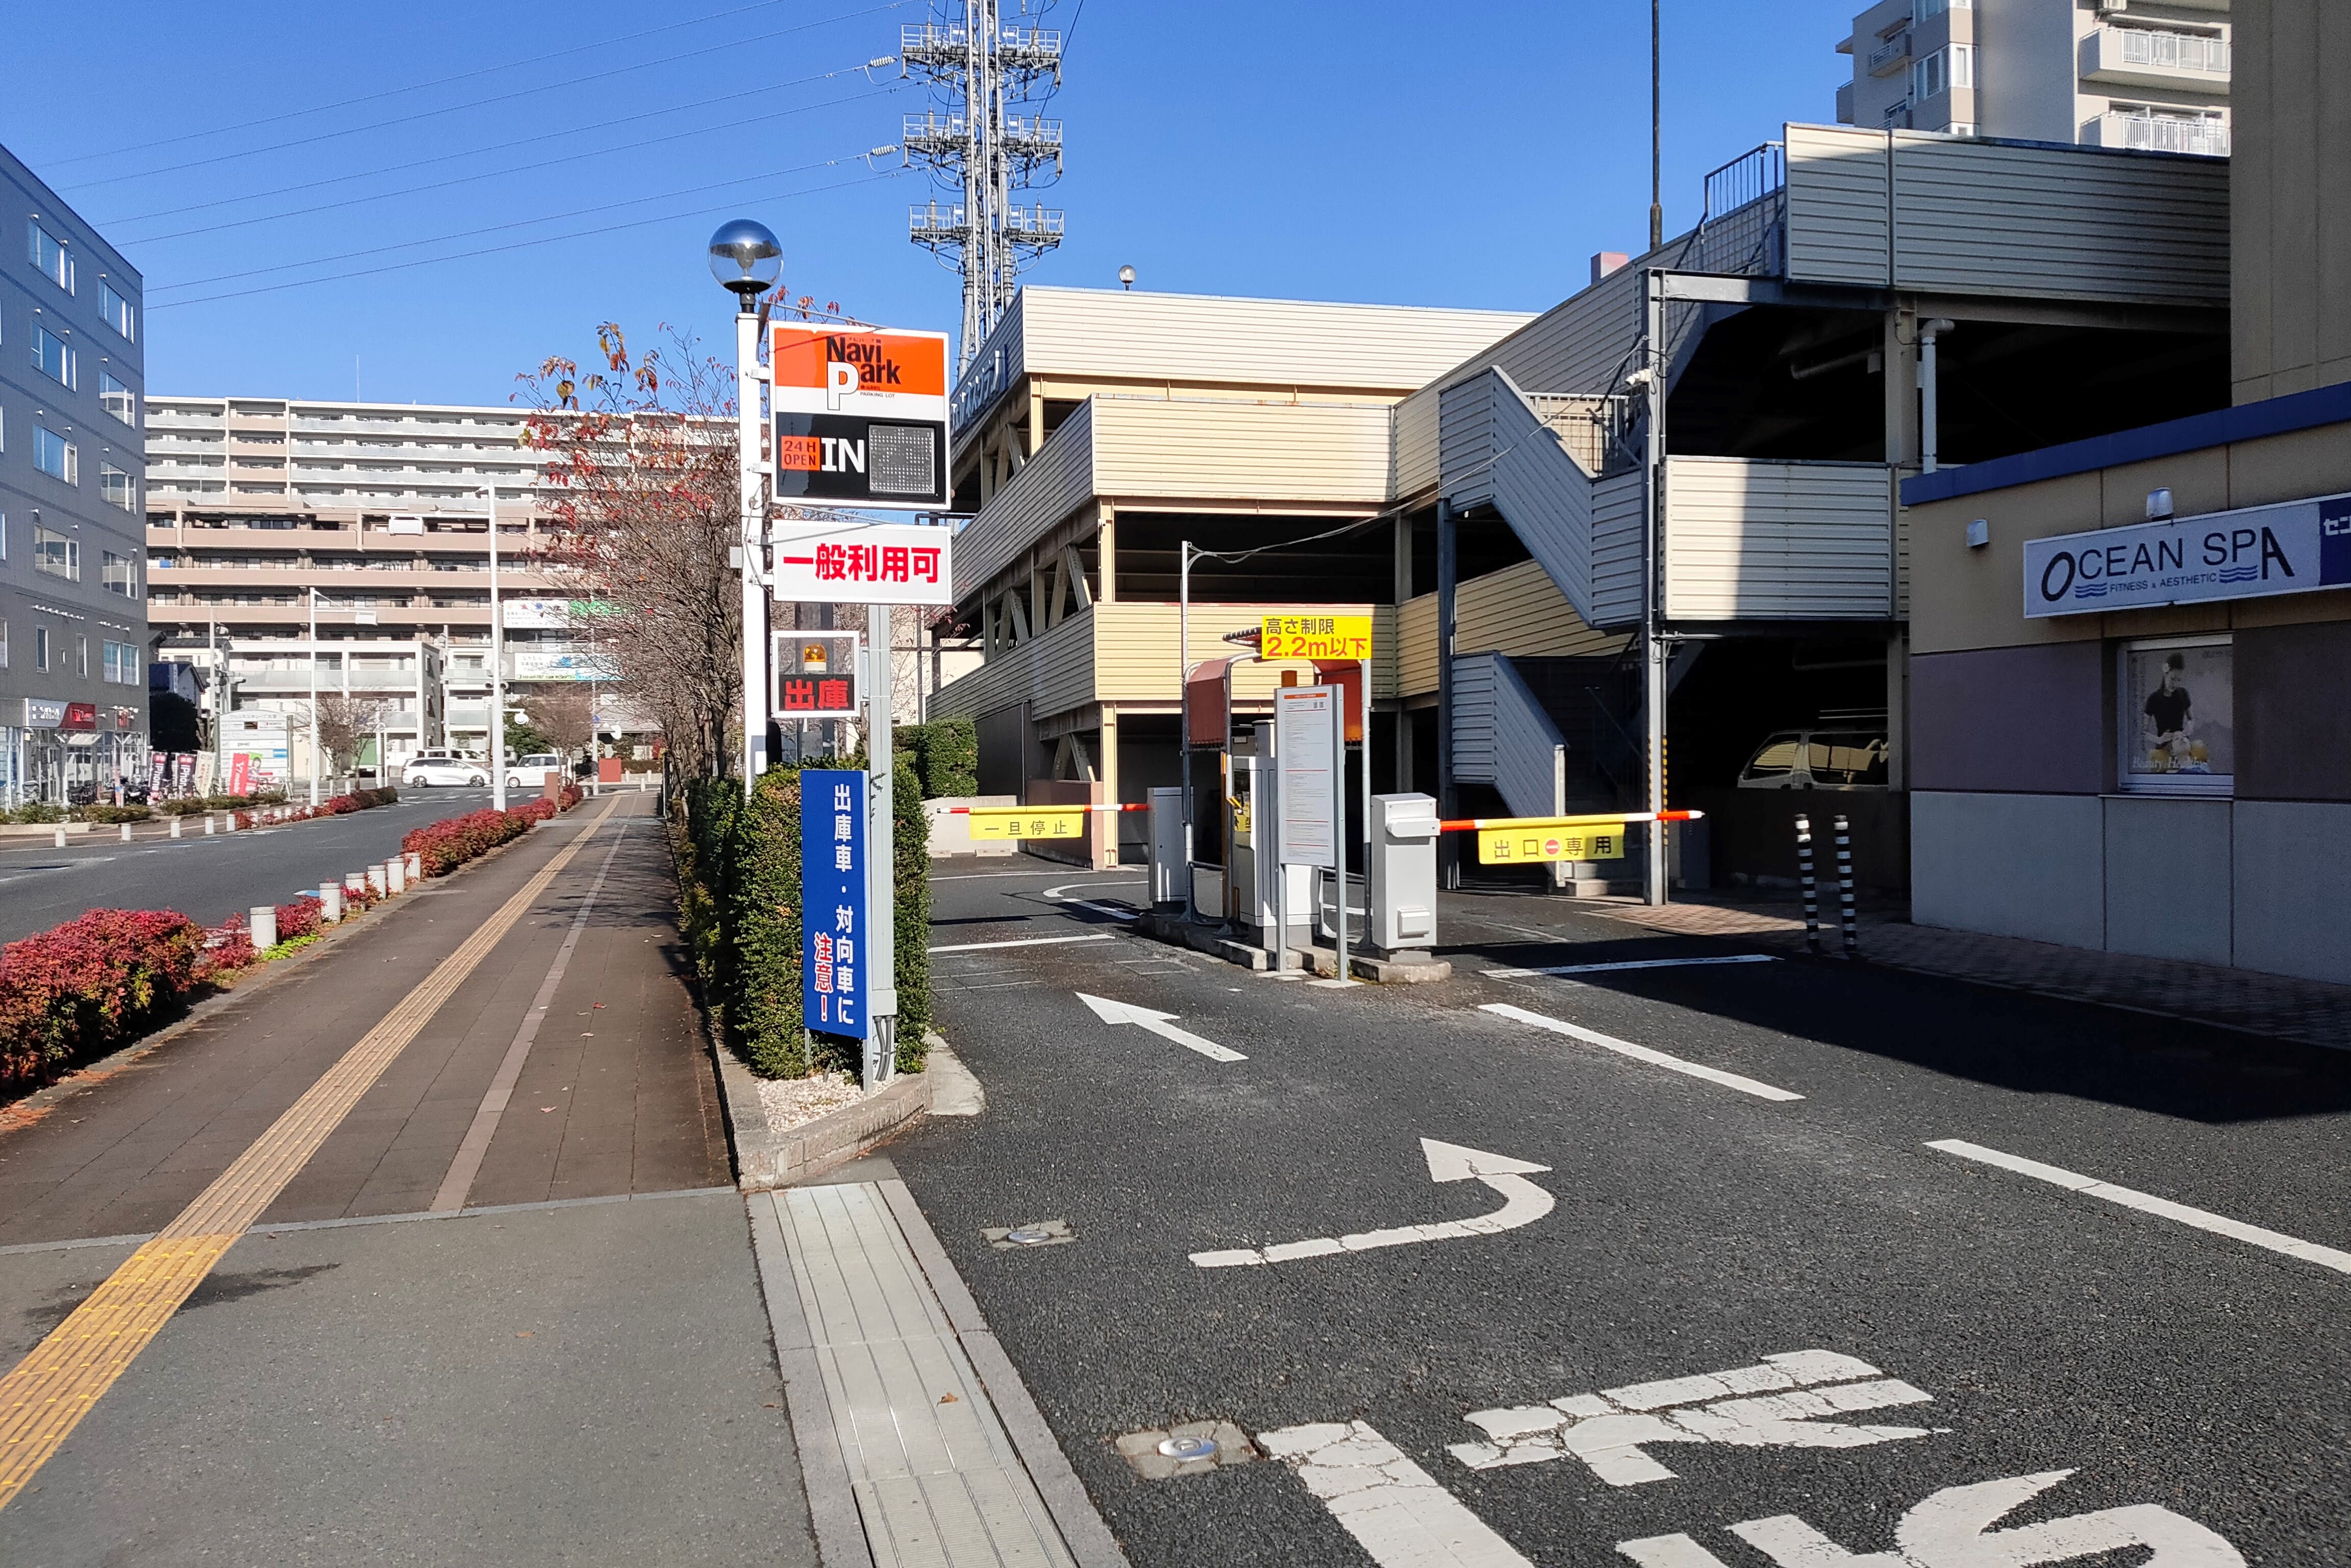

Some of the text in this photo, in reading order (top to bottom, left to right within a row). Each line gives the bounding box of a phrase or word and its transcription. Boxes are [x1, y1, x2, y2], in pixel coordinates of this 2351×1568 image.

[827, 336, 882, 363] Navi
[827, 359, 901, 411] Park
[784, 454, 816, 466] OPEN
[821, 437, 864, 473] IN
[783, 542, 941, 583] 一般利用可
[2041, 526, 2294, 601] OCEAN SPA
[2110, 580, 2148, 593] FITNESS
[2160, 573, 2217, 588] AESTHETIC
[1266, 618, 1334, 635] 高さ制限
[1266, 636, 1368, 658] 2.2m以下
[785, 679, 849, 710] 出庫
[984, 820, 1068, 835] 一旦停止
[1494, 836, 1612, 859] 出口 専用
[834, 784, 855, 1026] 出庫車・対向車に
